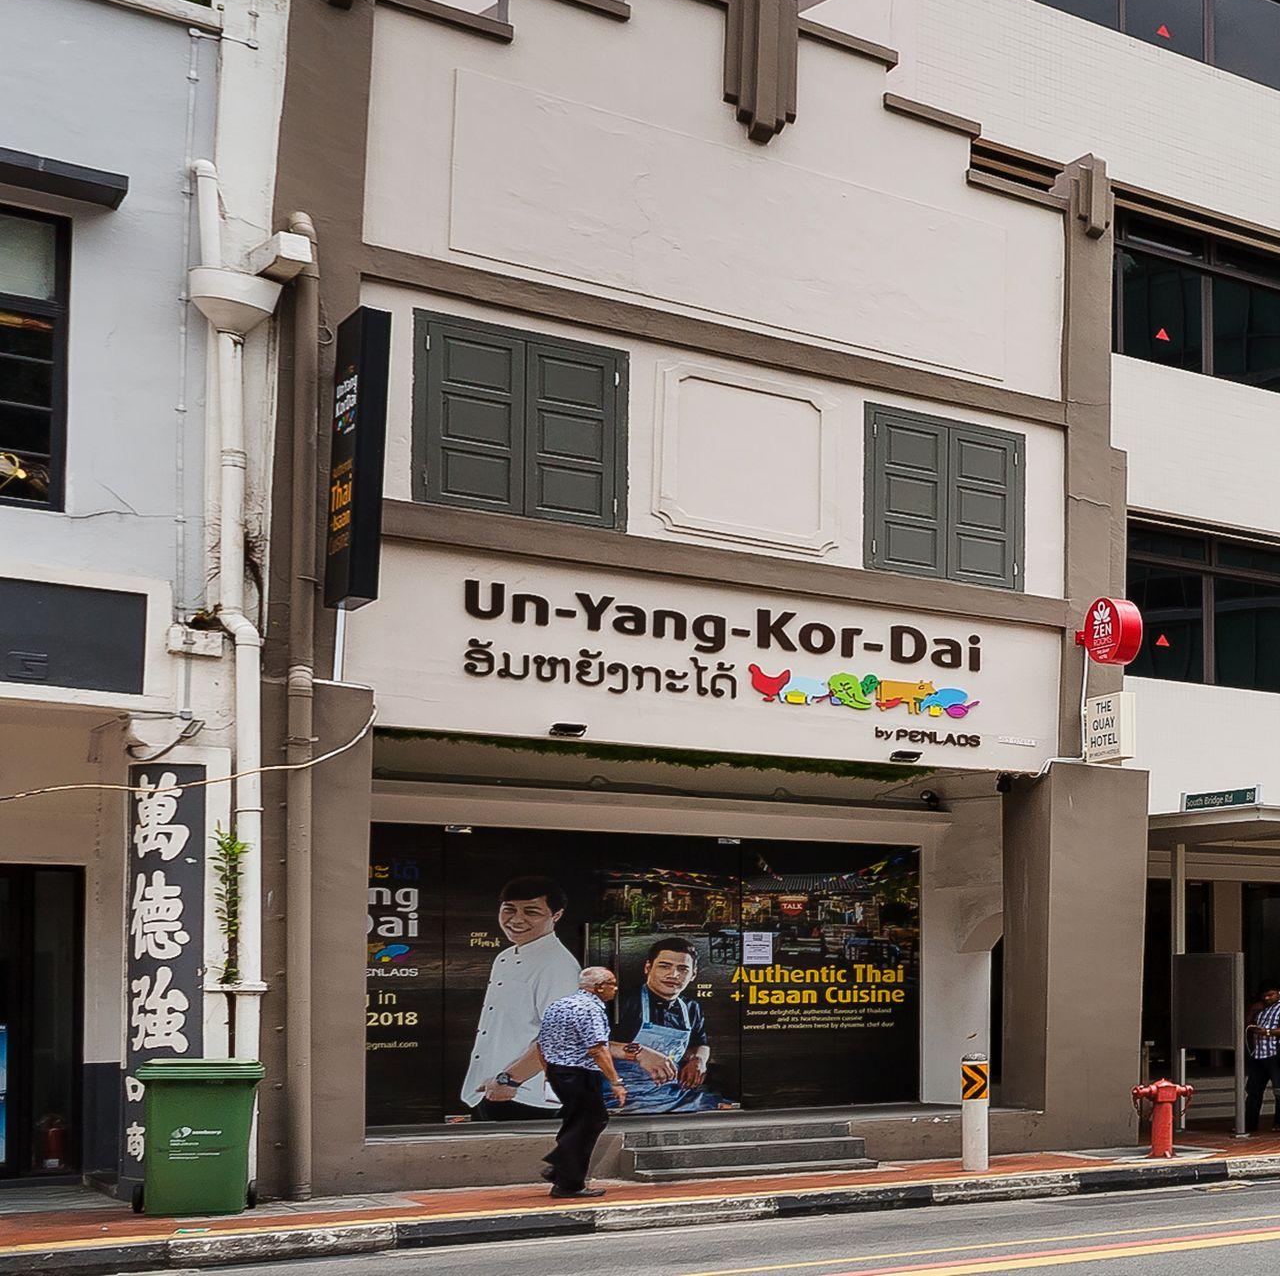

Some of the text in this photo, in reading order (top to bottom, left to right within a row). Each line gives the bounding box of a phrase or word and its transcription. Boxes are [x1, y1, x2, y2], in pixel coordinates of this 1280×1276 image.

[464, 579, 982, 672] Un-Yang-Kor-Dai
[1093, 622, 1112, 639] ZEN
[1096, 700, 1112, 714] THE
[1092, 716, 1115, 731] QUAY
[874, 727, 893, 741] by
[895, 729, 981, 747] PENLAOS
[1090, 733, 1118, 748] HOTEL
[1224, 794, 1233, 803] Rd
[131, 771, 190, 1054] 萬德強
[731, 963, 904, 984] Authentic Thai
[378, 990, 397, 1005] in
[749, 985, 818, 1005] Isaan
[825, 984, 905, 1003] Cuisine
[367, 1011, 418, 1027] 2018
